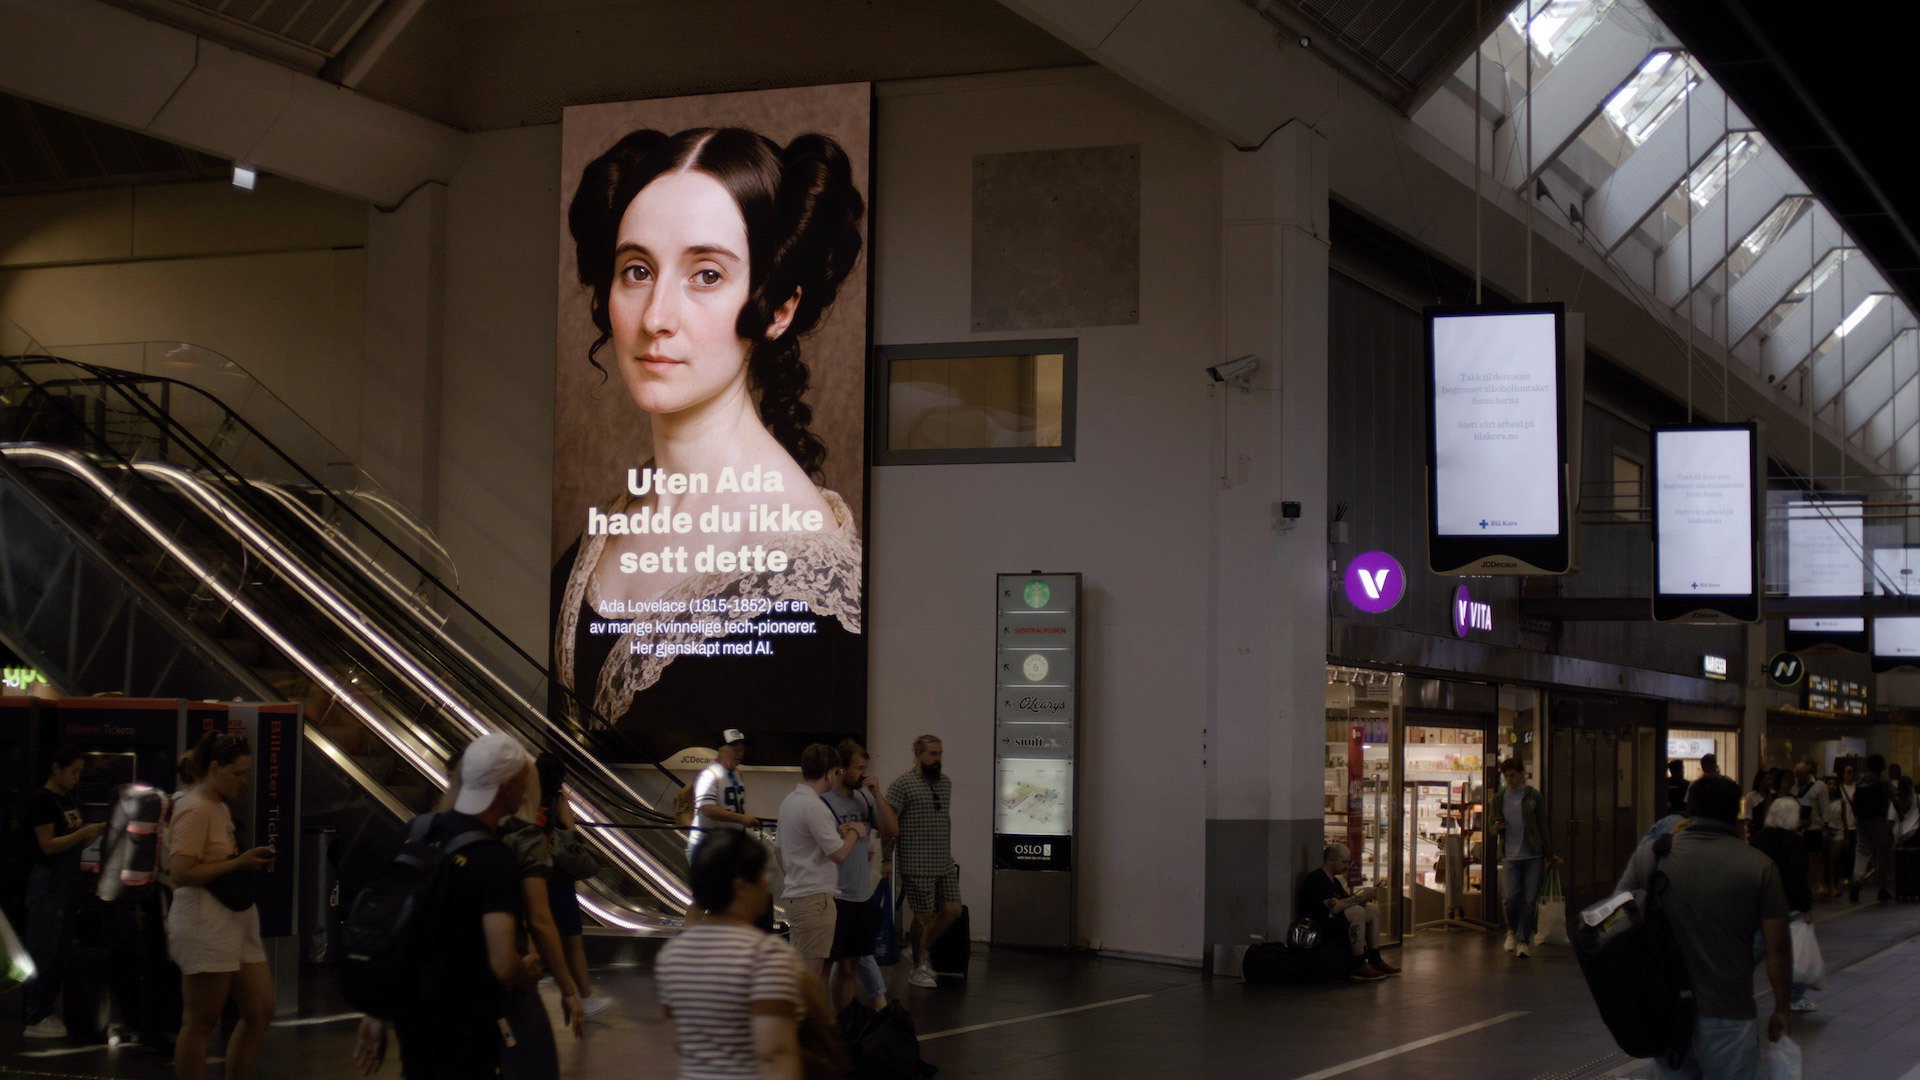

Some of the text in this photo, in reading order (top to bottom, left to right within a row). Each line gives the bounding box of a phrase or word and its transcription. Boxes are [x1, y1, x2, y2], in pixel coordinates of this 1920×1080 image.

[627, 465, 784, 496] Uten Ada
[588, 503, 824, 535] hadde du ikke
[619, 545, 788, 573] sett dette
[599, 598, 809, 614] Ada Lovelace (1815-1852) er en
[1470, 601, 1493, 631] VITA
[589, 620, 817, 636] av mange kvinnelige tech-pionerer.
[630, 641, 774, 657] Her gjenskapt med AI.
[268, 720, 282, 800] Billetter
[1015, 844, 1042, 855] OSLO
